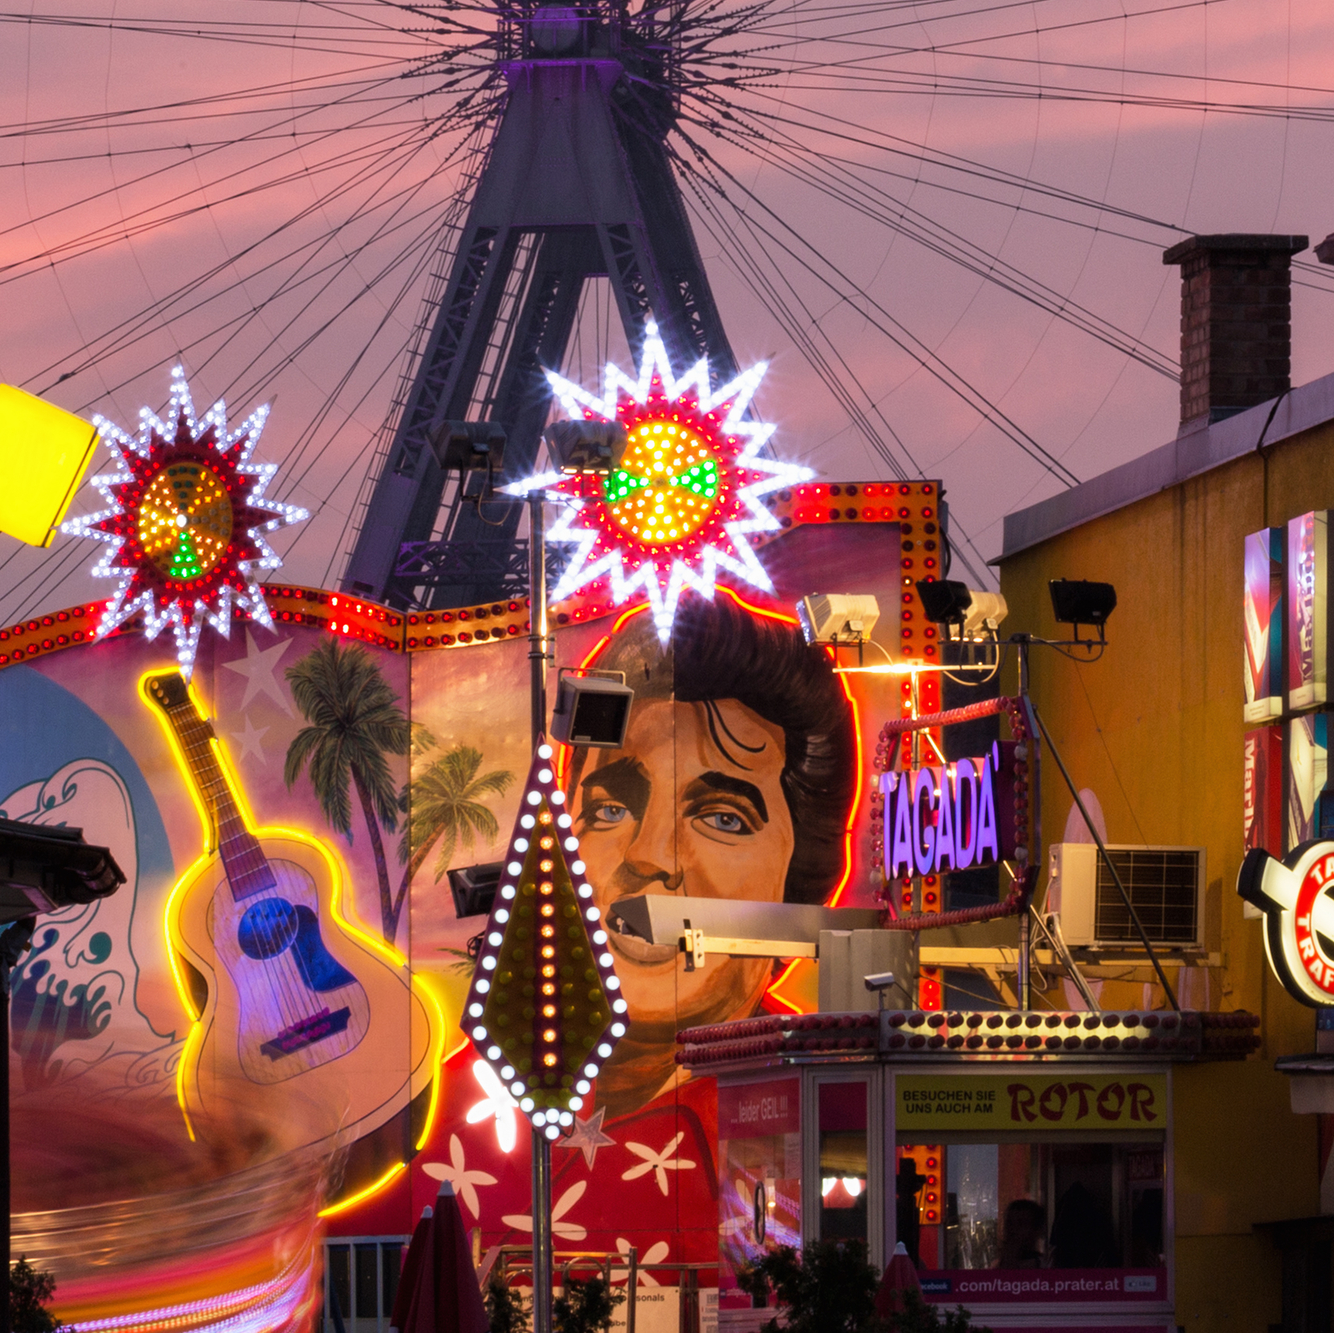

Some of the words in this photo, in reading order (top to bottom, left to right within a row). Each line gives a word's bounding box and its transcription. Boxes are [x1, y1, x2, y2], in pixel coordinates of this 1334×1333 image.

[903, 1090, 973, 1102] BESUCHEN
[976, 1090, 996, 1101] SIE
[1007, 1082, 1158, 1122] ROTOR
[906, 1103, 932, 1114] UNS
[935, 1103, 971, 1114] AUCH
[974, 1103, 993, 1114] AM
[955, 1278, 1120, 1294] .com/tagada.prater.at
